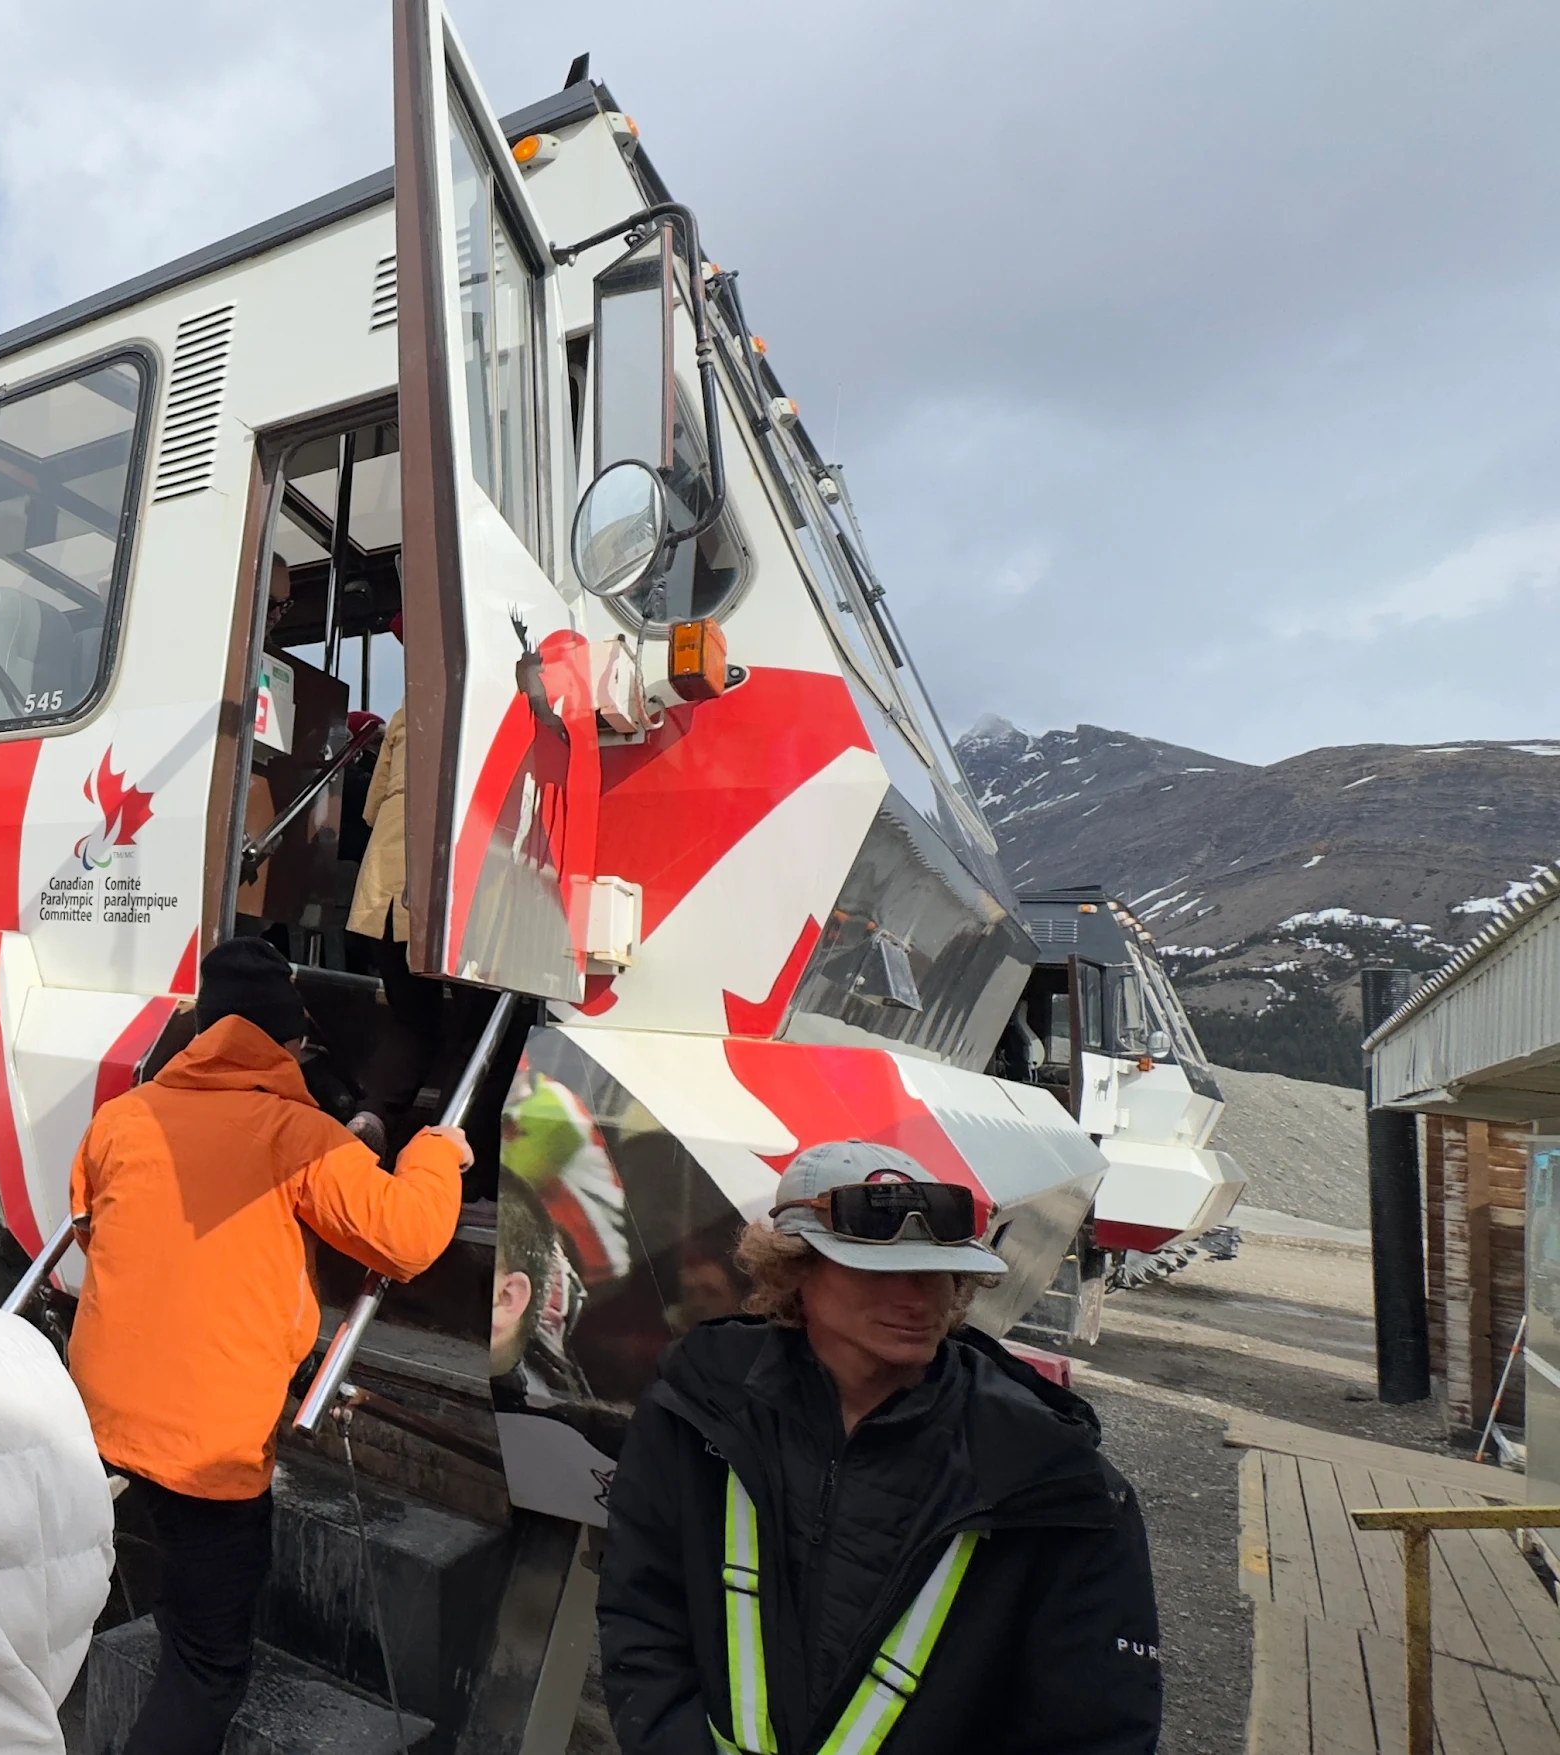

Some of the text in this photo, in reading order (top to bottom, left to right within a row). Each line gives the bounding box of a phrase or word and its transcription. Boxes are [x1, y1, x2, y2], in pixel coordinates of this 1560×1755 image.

[24, 690, 63, 713] 545
[49, 876, 94, 891] Canadian
[105, 876, 141, 891] Comité
[40, 892, 93, 909] Paralympic
[104, 893, 178, 911] paralympique
[39, 907, 92, 922] Committee
[103, 909, 151, 923] canadien
